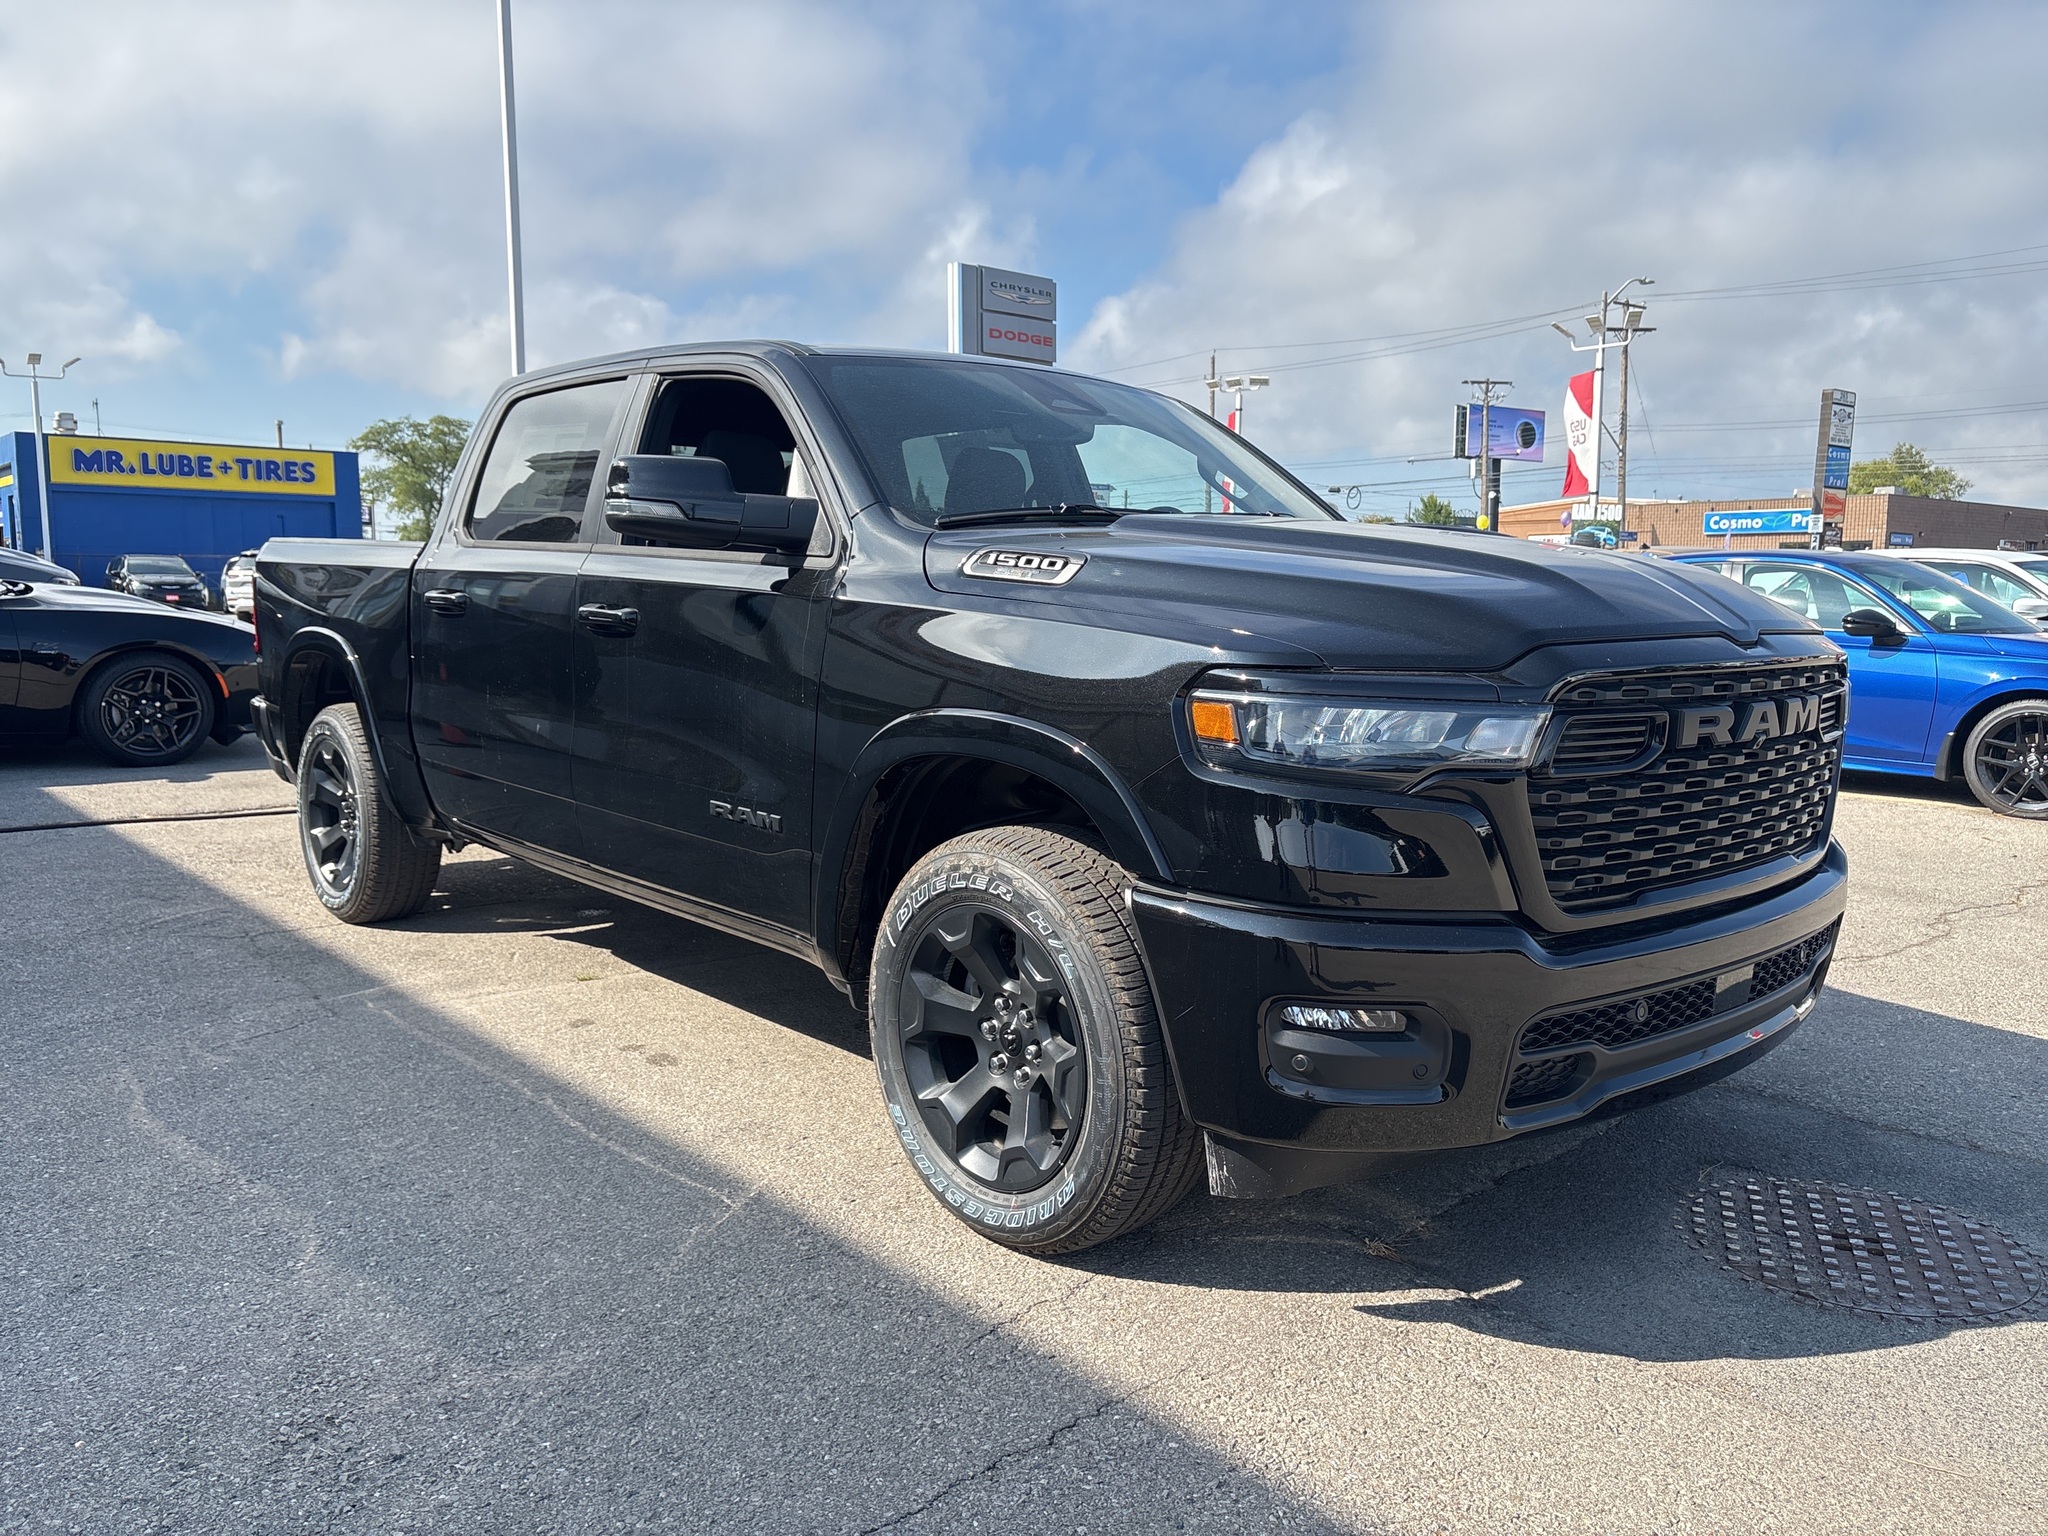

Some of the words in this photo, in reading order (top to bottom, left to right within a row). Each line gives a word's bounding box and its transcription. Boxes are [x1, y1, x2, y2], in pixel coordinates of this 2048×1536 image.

[990, 281, 1052, 298] CHRYSLER
[988, 327, 1053, 347] DODGE
[139, 452, 214, 478] LUBE
[235, 458, 316, 484] TIRES
[1596, 504, 1623, 521] 1500
[1709, 515, 1763, 530] Cosmo
[1791, 513, 1811, 528] Pr
[986, 551, 1066, 571] 1500
[1677, 695, 1820, 749] RAM
[709, 800, 784, 834] RAM
[895, 872, 1014, 932] DUELER
[888, 1103, 1077, 1228] BRIDGESTONE
